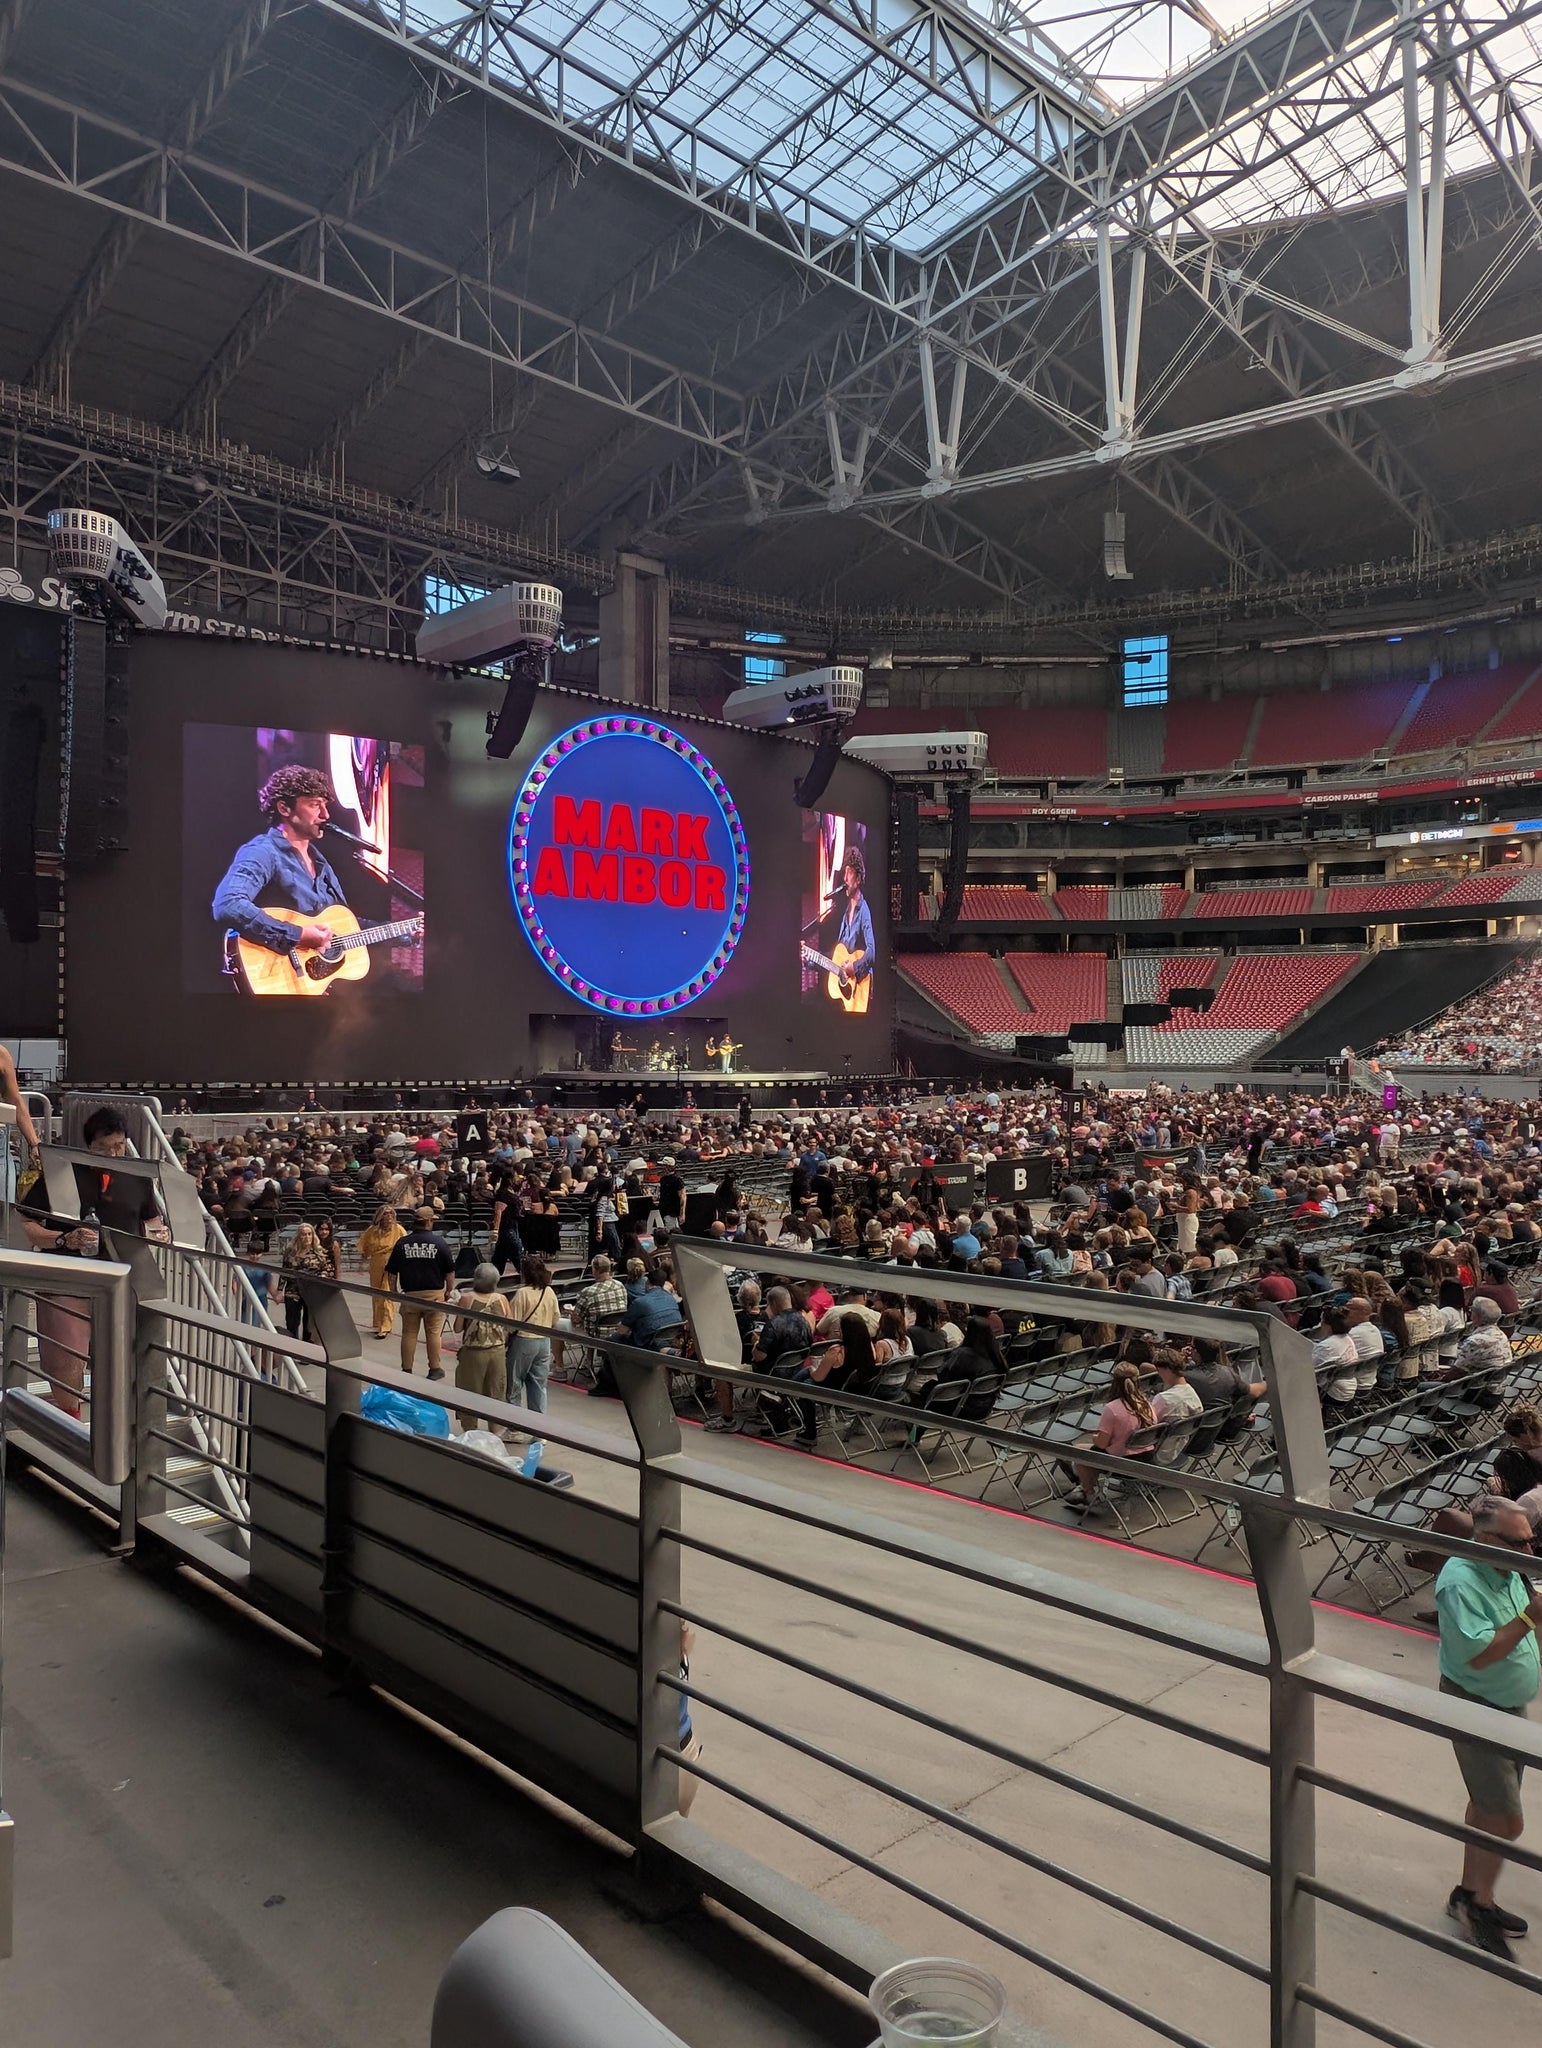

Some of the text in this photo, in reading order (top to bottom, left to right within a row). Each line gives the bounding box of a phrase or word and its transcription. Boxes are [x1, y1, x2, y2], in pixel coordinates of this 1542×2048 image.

[1467, 777, 1495, 786] ERNIE
[1497, 771, 1536, 782] NEVERS
[1304, 795, 1341, 803] CARSON
[1342, 792, 1379, 800] PALMER
[553, 795, 710, 861] MARK
[532, 847, 727, 911] AMBOR
[1073, 1101, 1081, 1113] B
[466, 1124, 482, 1142] A
[1528, 1123, 1536, 1138] D
[1014, 1168, 1028, 1191] B
